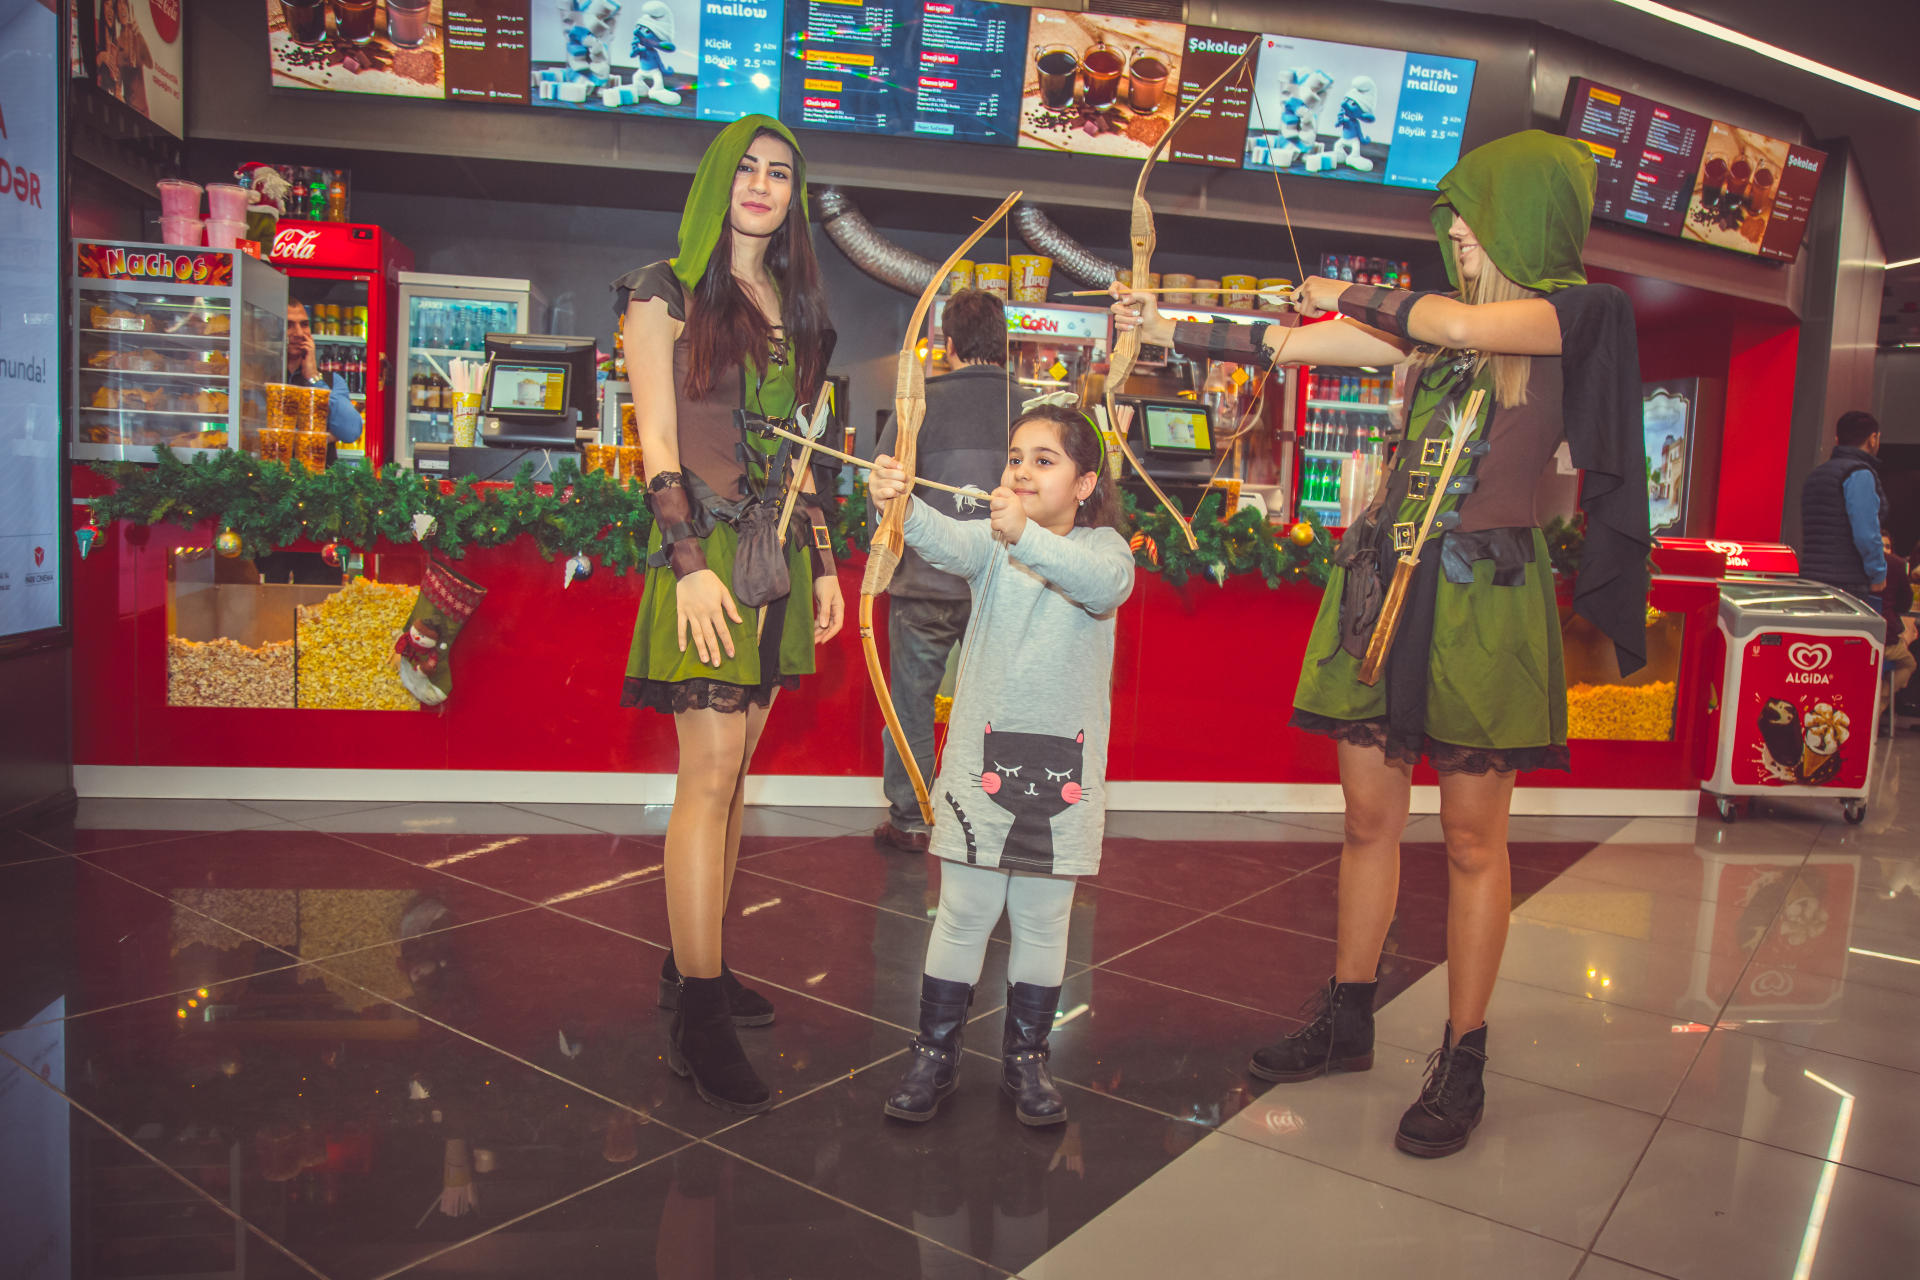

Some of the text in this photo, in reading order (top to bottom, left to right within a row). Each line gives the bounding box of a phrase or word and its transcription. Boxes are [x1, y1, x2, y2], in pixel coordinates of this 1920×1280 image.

[706, 3, 767, 19] mallow
[705, 38, 732, 50] Kiçik
[754, 42, 762, 52] 2
[1188, 37, 1248, 56] Şokolad
[704, 54, 737, 68] Böyük
[744, 58, 761, 69] 2.5
[1409, 64, 1459, 80] Marsh-
[1406, 79, 1459, 95] mallow
[1401, 111, 1424, 122] Kiçik
[1442, 116, 1449, 125] 2
[1398, 126, 1427, 138] Böyük
[1431, 129, 1446, 139] 2.5
[271, 228, 322, 259] Cola
[106, 248, 208, 281] Nachos
[1726, 556, 1748, 567] GIDA
[1785, 671, 1830, 685] ALGIDA
